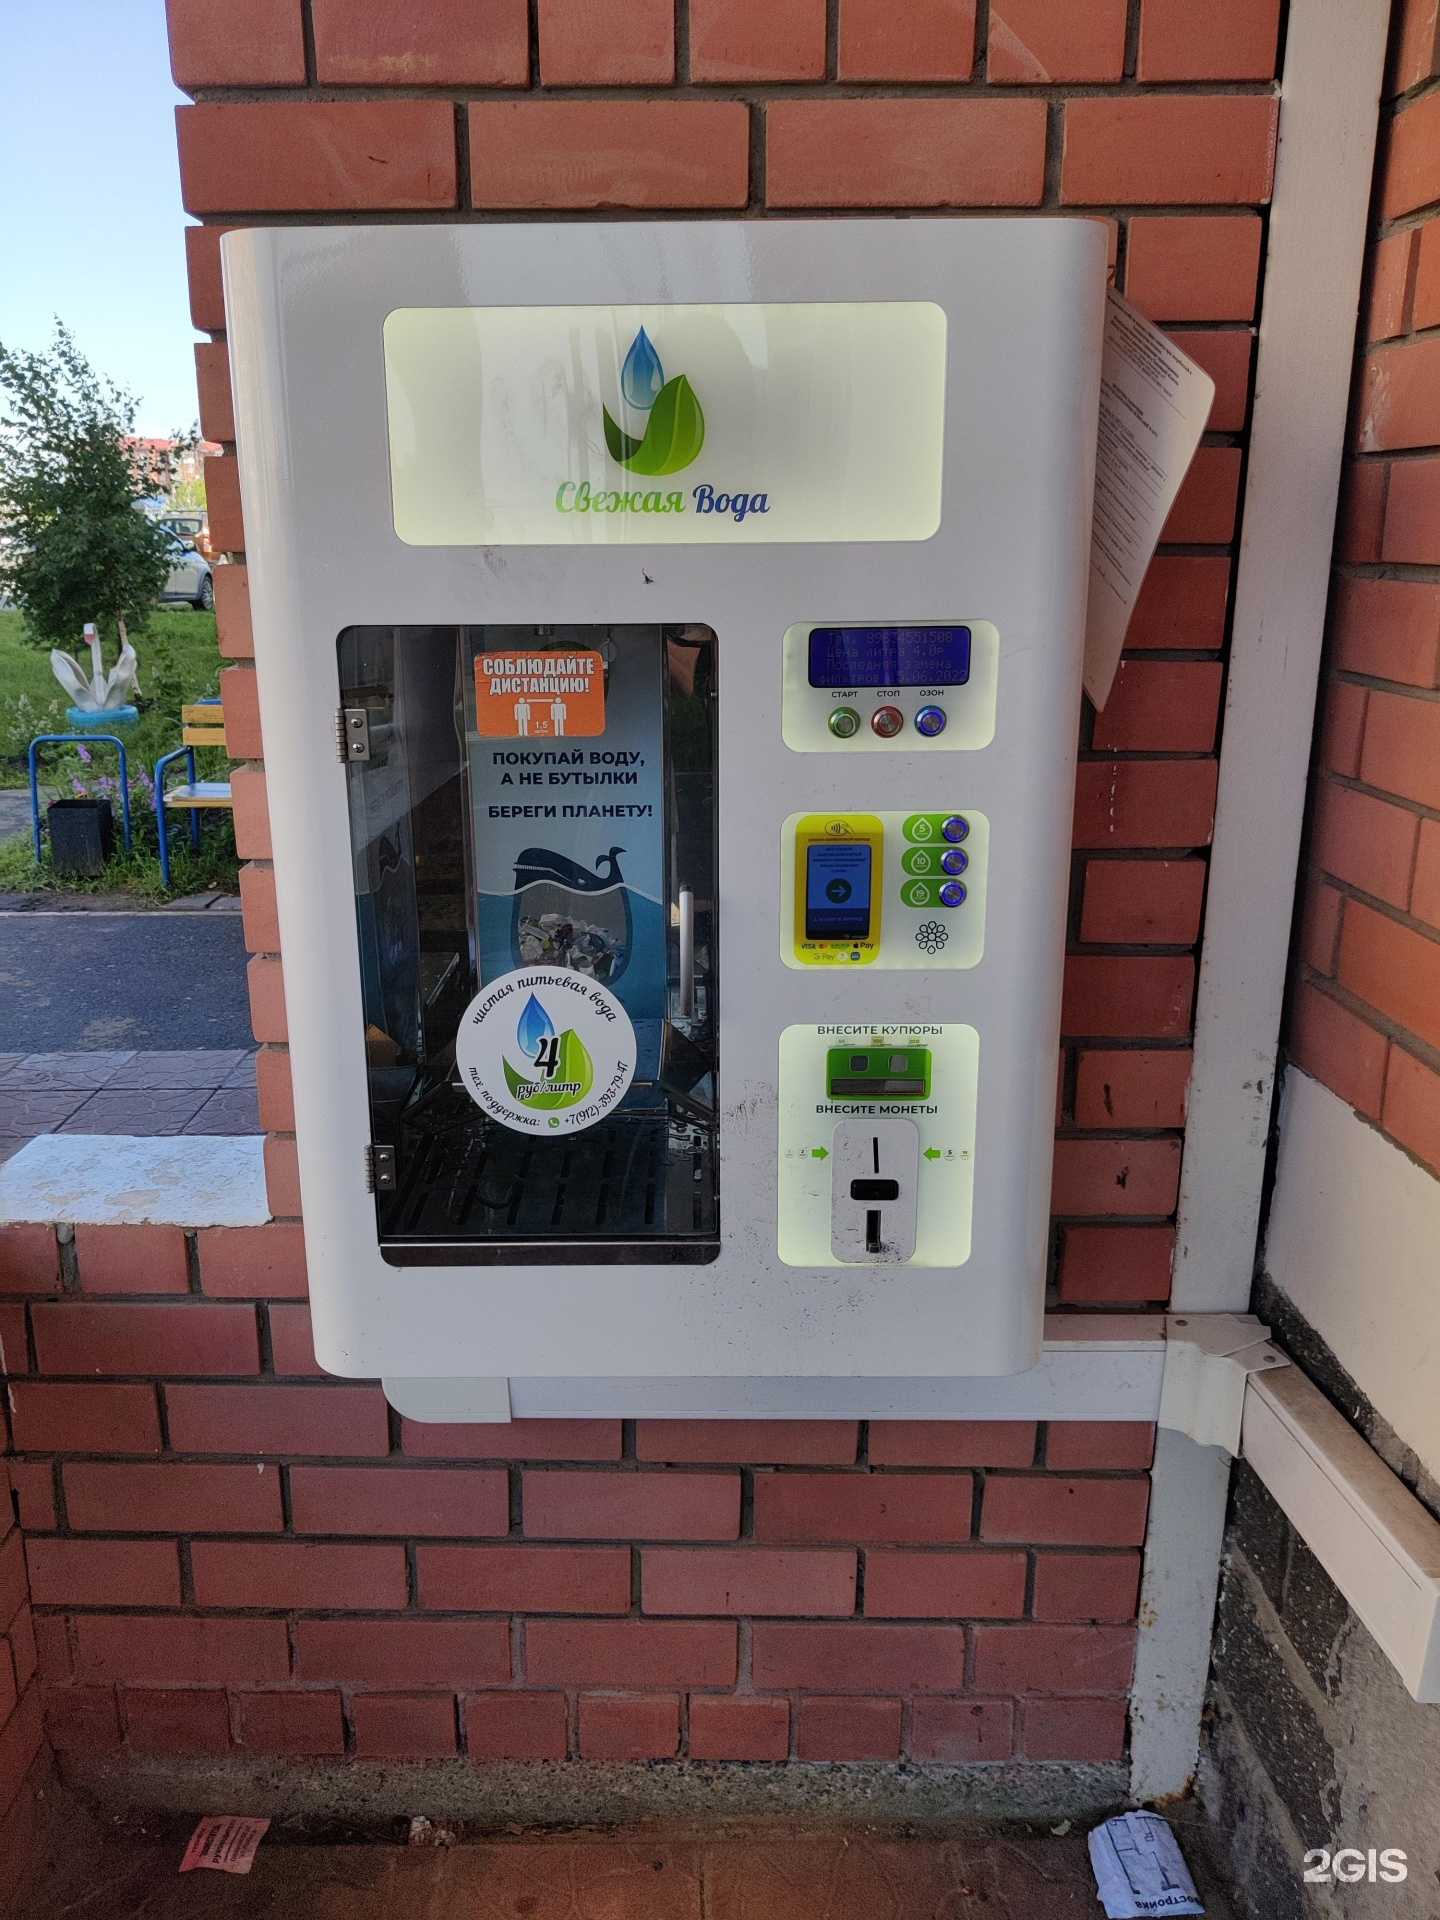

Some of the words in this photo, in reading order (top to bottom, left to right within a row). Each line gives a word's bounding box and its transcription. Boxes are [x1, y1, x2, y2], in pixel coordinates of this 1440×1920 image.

[555, 481, 687, 513] Свежая
[692, 484, 771, 522] Вода
[482, 656, 595, 677] СОБЛЮДАЙТЕ
[489, 677, 590, 695] ДИСТАНЦИЮ!
[831, 690, 858, 698] СТАРТ
[919, 689, 945, 697] ОЗОН
[492, 749, 584, 765] ПОКУПАЙ
[589, 751, 645, 767] ВОДУ,
[500, 772, 514, 785] А
[519, 772, 543, 785] НЕ
[548, 772, 638, 785] БУТЫЛКИ
[488, 805, 557, 818] БЕРЕГИ
[562, 804, 653, 818] ПЛАНЕТУ!
[472, 983, 515, 1025] чистая
[517, 975, 588, 996] питьевая
[589, 991, 617, 1024] вода
[817, 1025, 878, 1035] ВНЕСИТЕ
[881, 1025, 943, 1035] КУПЮРЫ
[534, 1037, 560, 1078] 4
[480, 1089, 541, 1126] поддержка:
[816, 1104, 876, 1114] ВНЕСИТЕ
[879, 1104, 938, 1114] МОНЕТЫ
